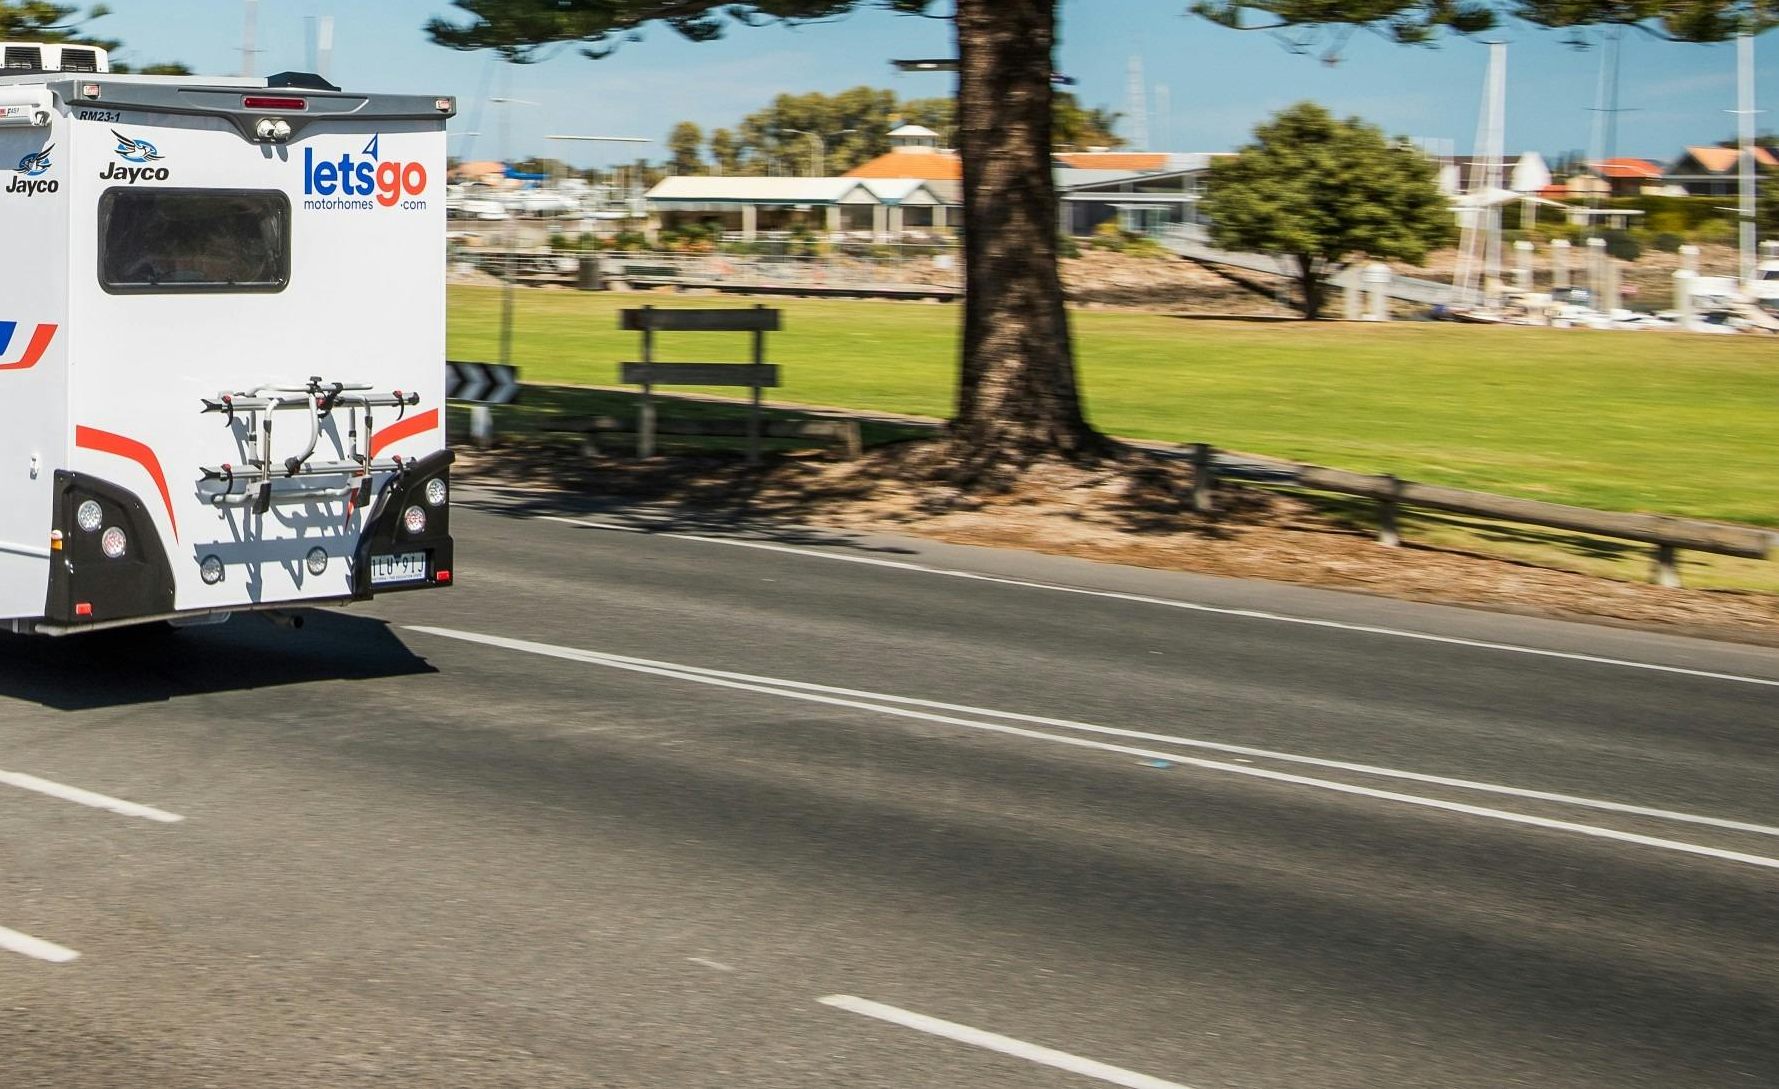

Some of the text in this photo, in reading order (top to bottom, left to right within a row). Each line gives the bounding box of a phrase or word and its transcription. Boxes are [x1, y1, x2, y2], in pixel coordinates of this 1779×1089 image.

[79, 110, 121, 123] RM23-1
[99, 161, 170, 184] Jayco
[5, 175, 59, 197] Jayco
[304, 196, 374, 210] motorhomes
